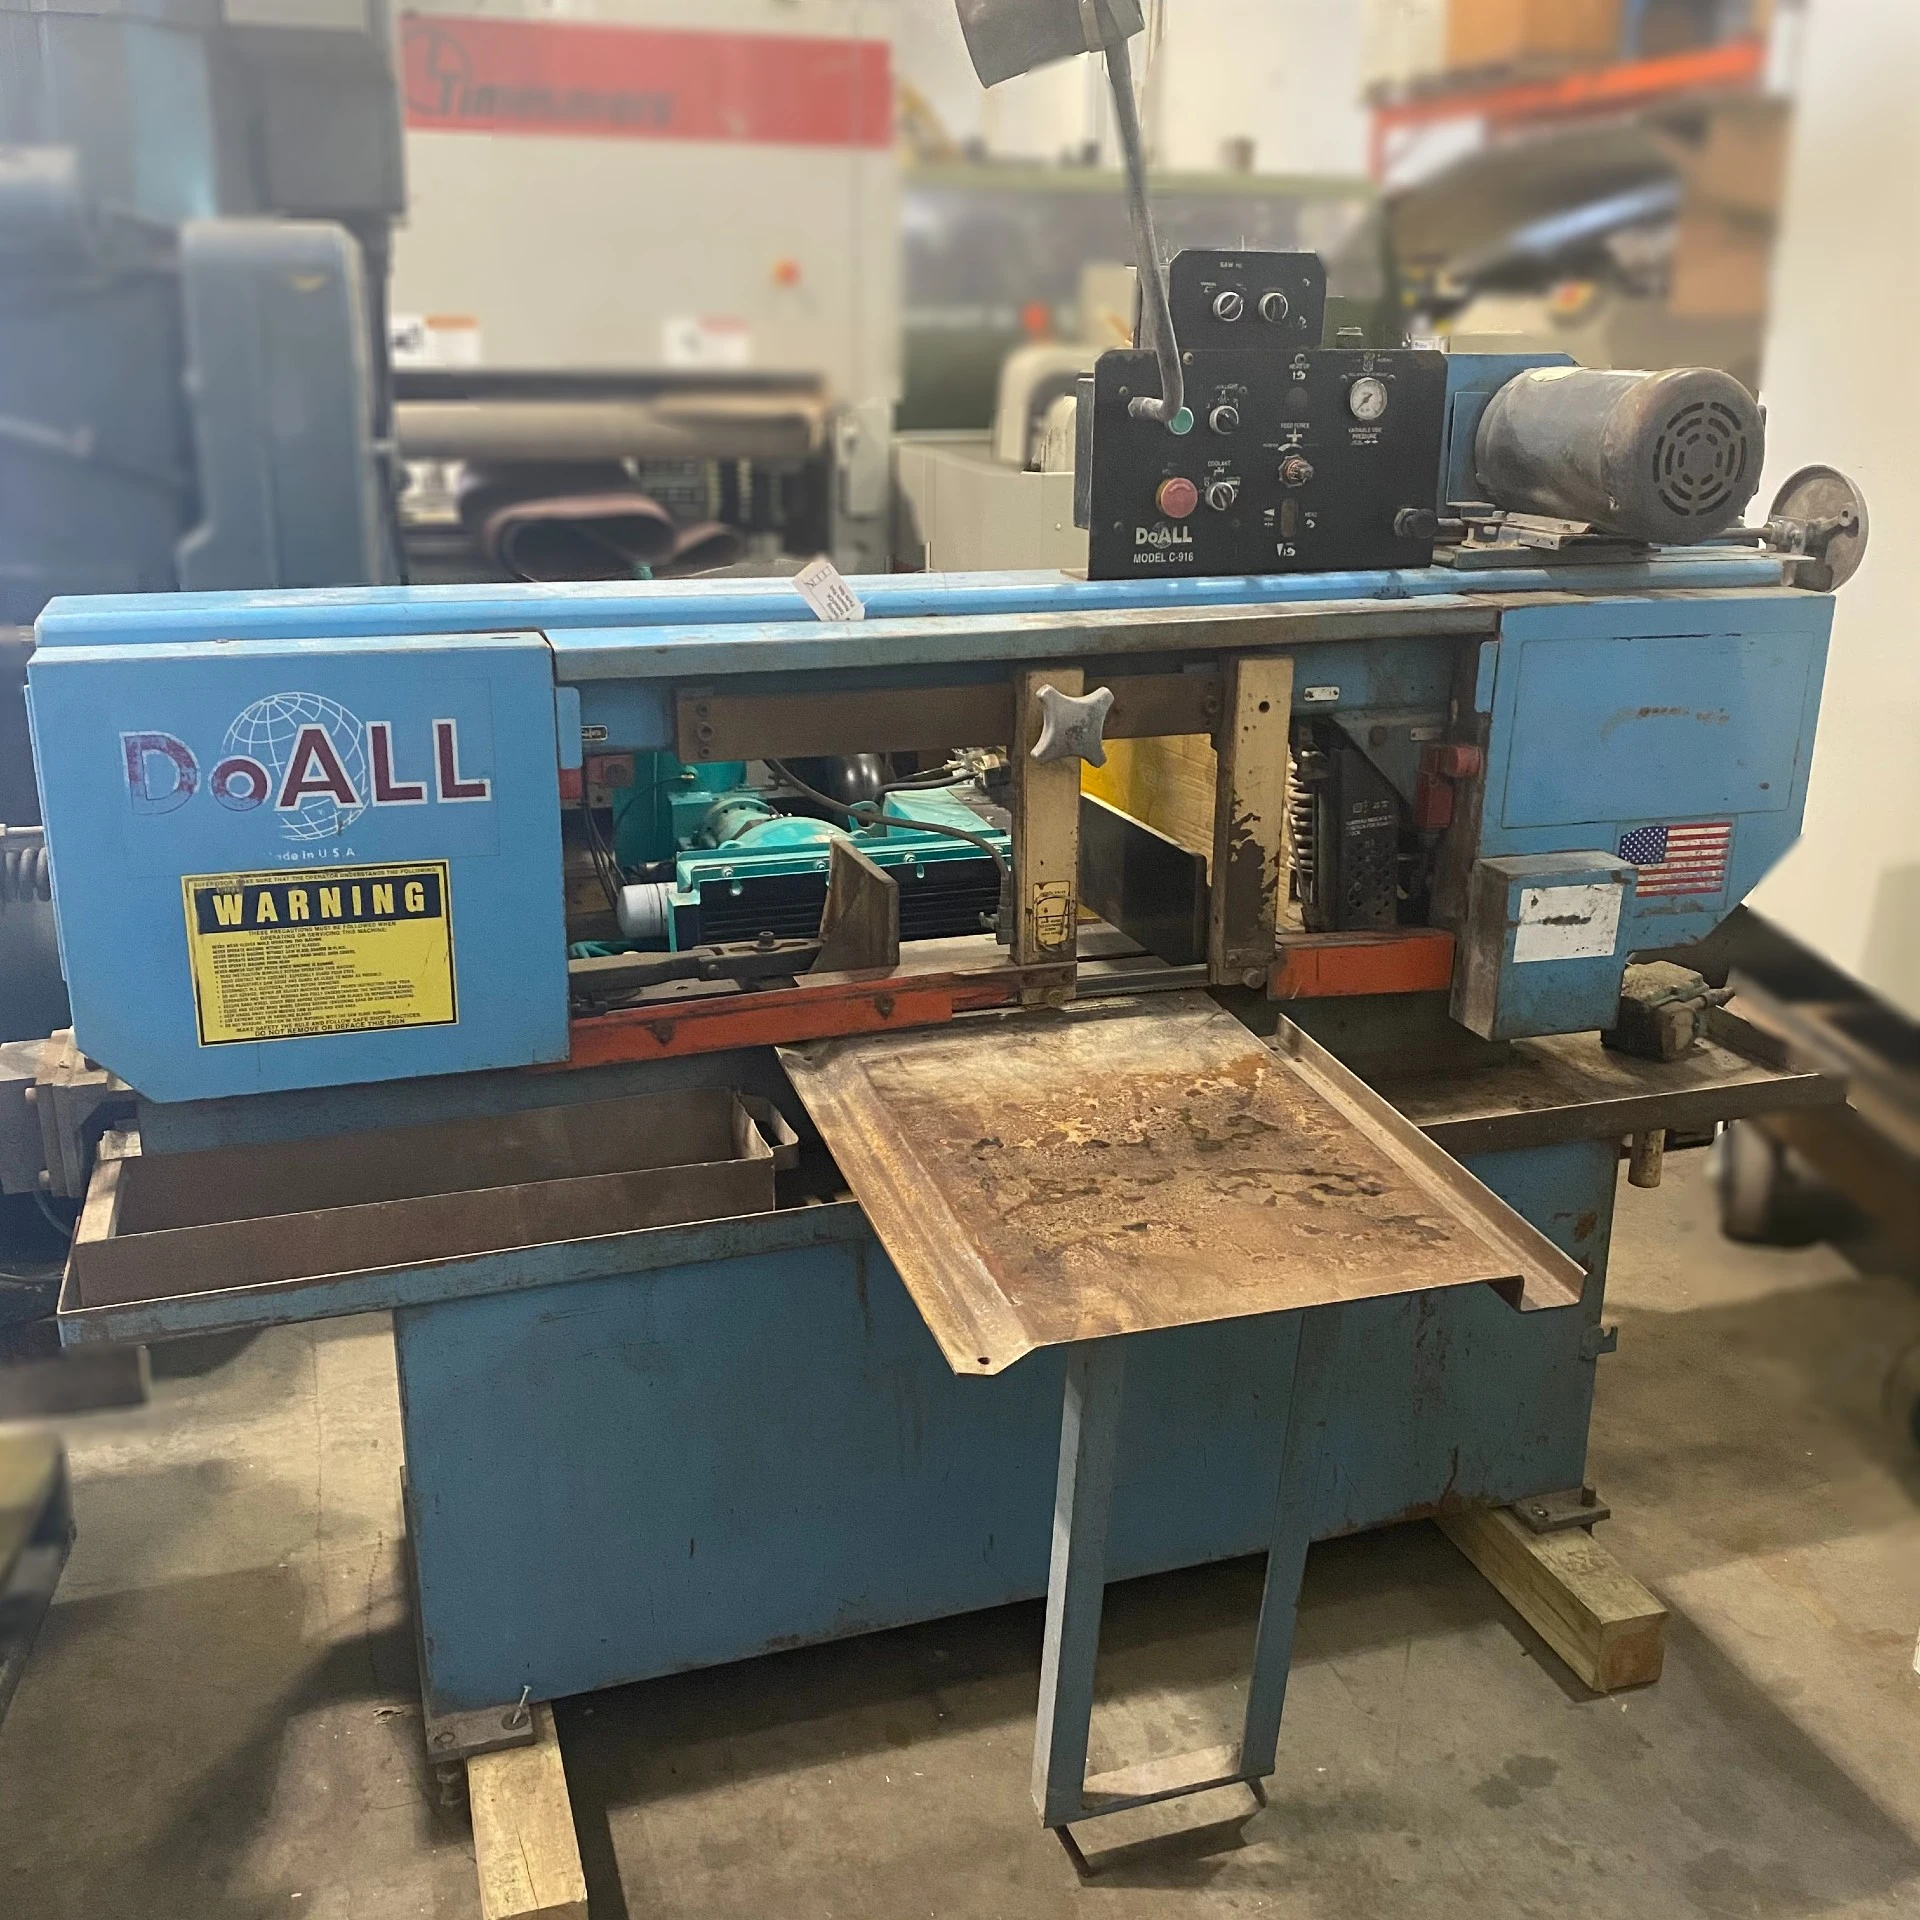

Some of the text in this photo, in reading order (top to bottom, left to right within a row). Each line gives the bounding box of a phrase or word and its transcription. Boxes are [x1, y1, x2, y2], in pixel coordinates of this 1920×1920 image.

[1135, 525, 1193, 545] DoALL
[1133, 552, 1194, 564] MODEL C-916
[120, 718, 491, 816] DoALL
[302, 850, 315, 860] in
[212, 880, 427, 926] WARNING
[259, 933, 294, 941] OPERATING
